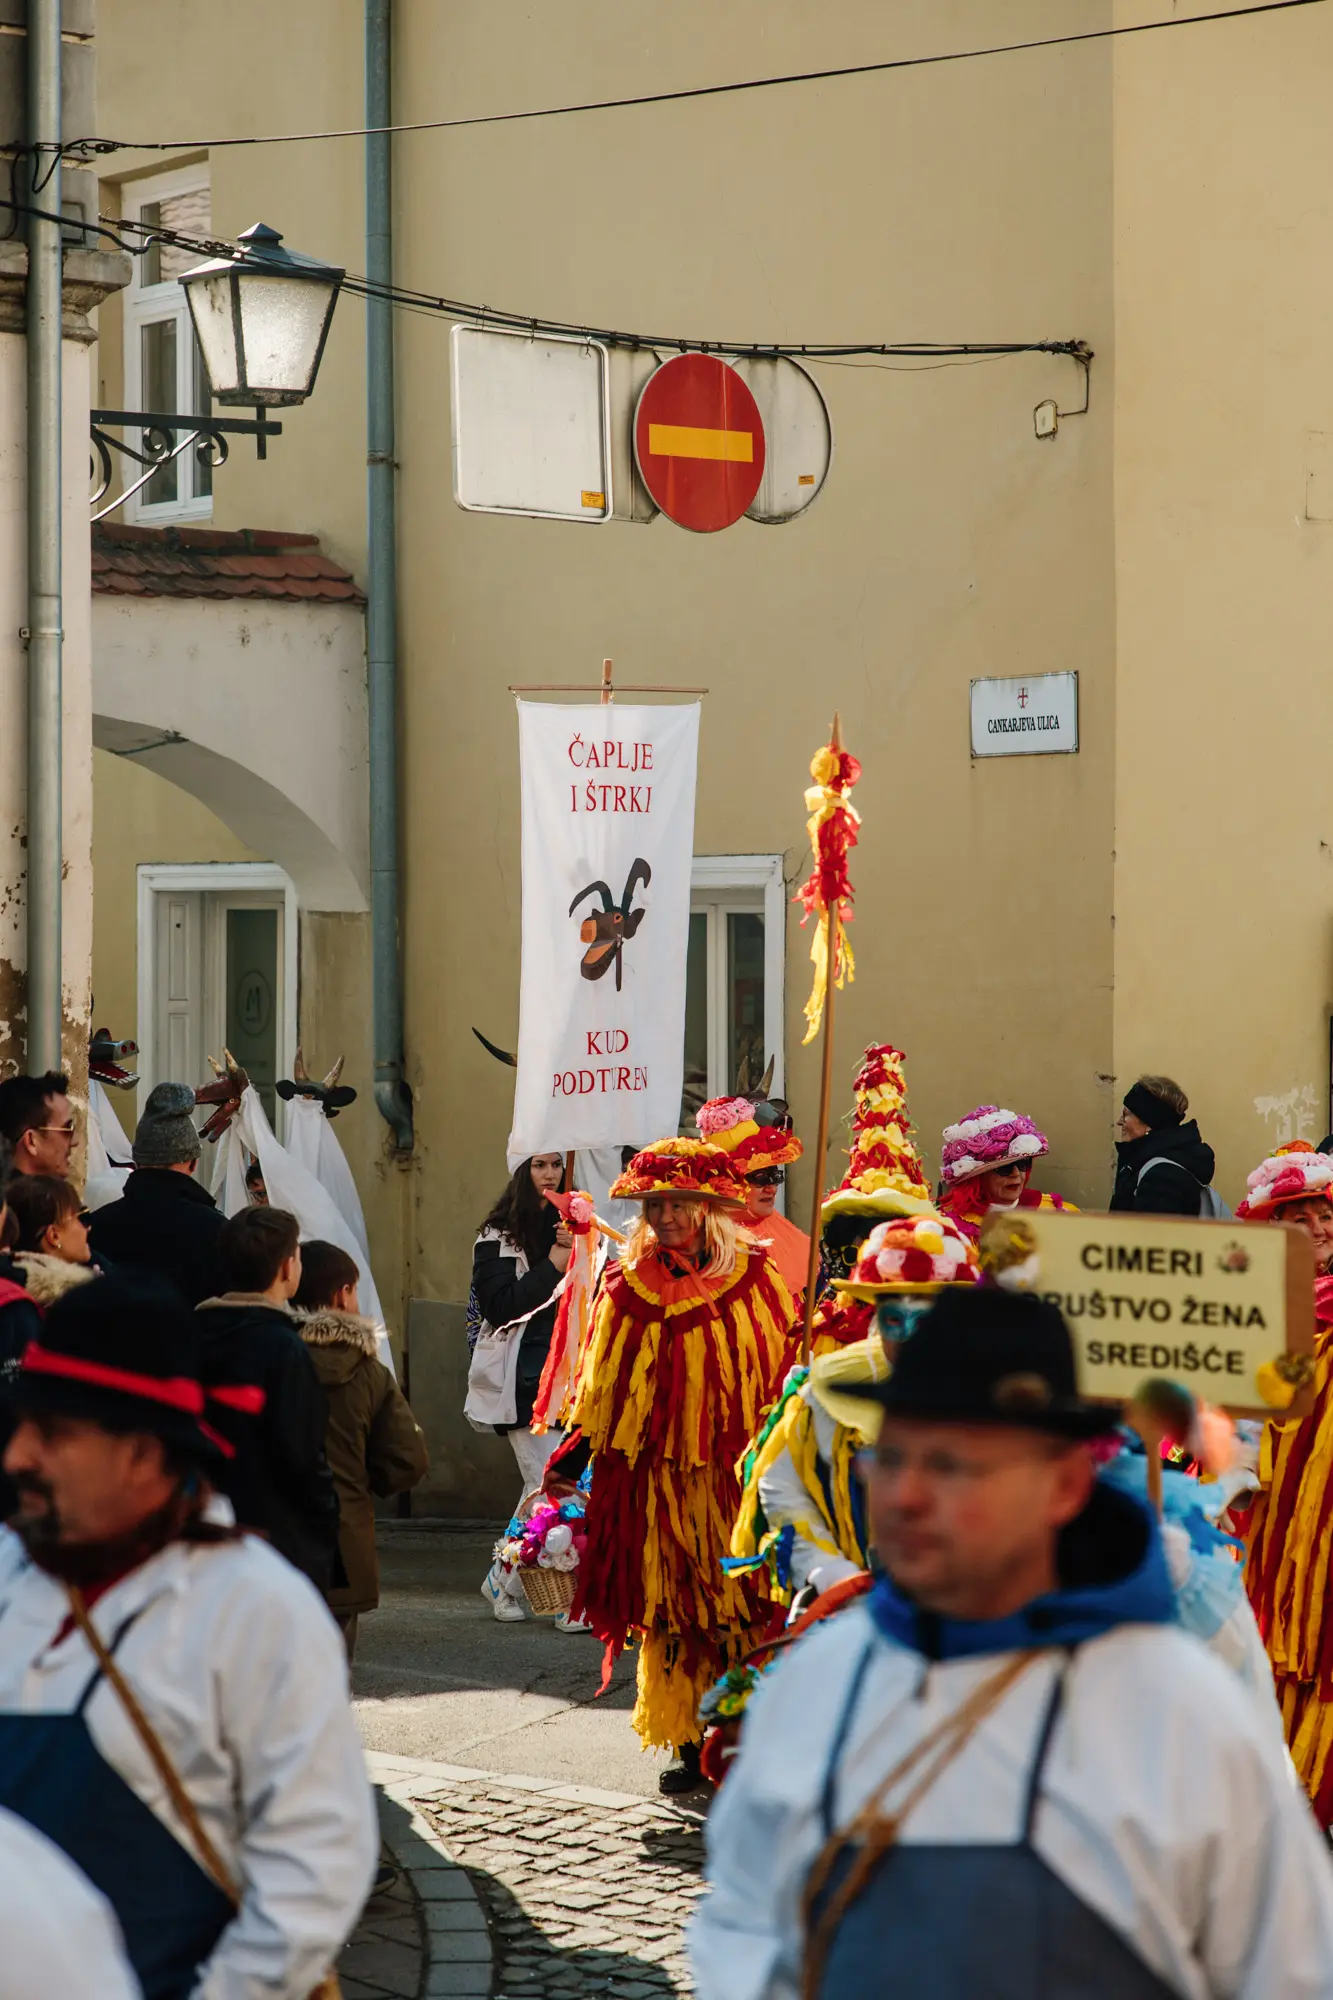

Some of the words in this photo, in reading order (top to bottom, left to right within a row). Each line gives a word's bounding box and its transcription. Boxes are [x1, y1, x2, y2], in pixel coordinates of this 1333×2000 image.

[988, 717, 1036, 733] CANKARJEVA
[1037, 715, 1060, 730] ULICA
[568, 732, 654, 772] ČAPLJE
[570, 785, 578, 812] I
[585, 778, 653, 813] ŠTRKI
[586, 1029, 629, 1055] KUD
[552, 1066, 648, 1098] PODTUREN
[1081, 1243, 1202, 1277] CIMERI
[1022, 1289, 1172, 1324] RUŠTVO
[1181, 1295, 1266, 1331] ŽENA
[1087, 1341, 1245, 1375] SREDIŠĆE
